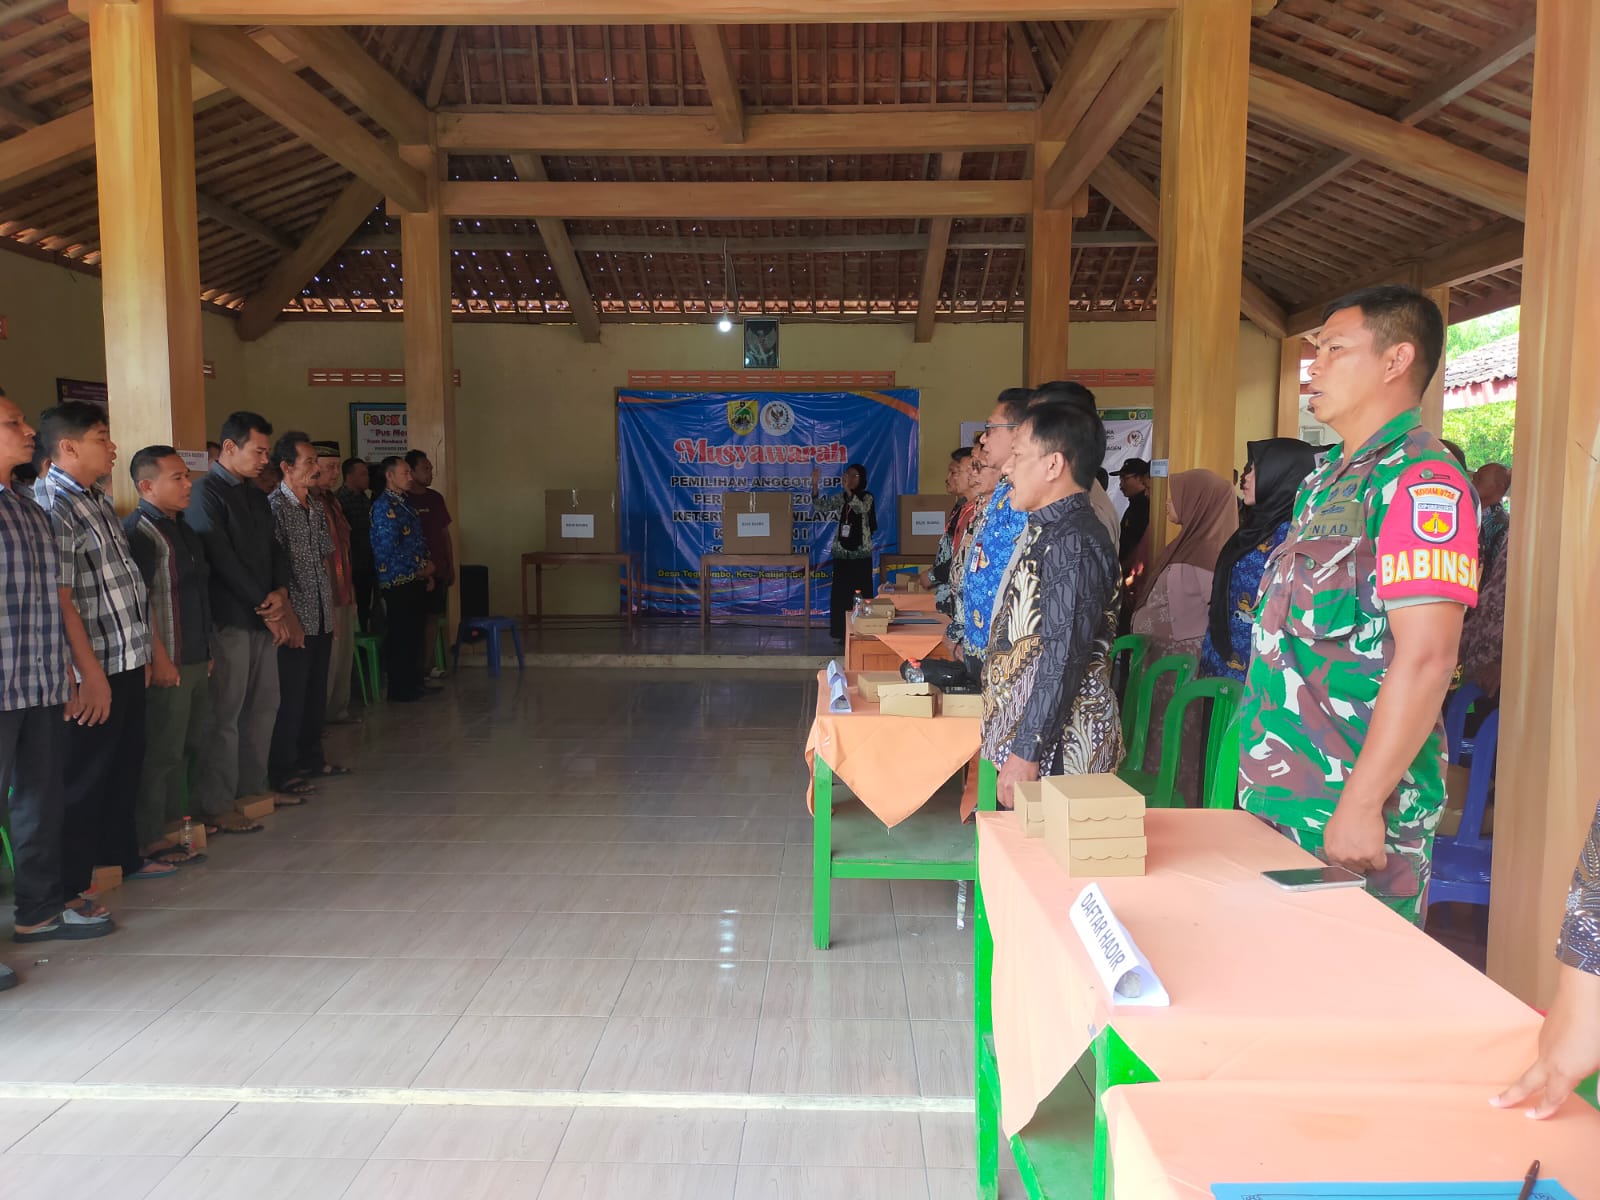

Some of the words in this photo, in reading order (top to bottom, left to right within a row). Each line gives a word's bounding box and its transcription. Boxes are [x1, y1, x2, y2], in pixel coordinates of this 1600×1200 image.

[674, 438, 848, 469] Musyawarah
[671, 476, 747, 487] PEMILIHAN
[751, 476, 813, 487] ANGGOT
[823, 477, 842, 487] BP
[673, 511, 723, 522] KETER
[792, 511, 840, 522] WILAYA
[1382, 548, 1478, 593] BABINSA
[1080, 892, 1108, 938] DAFTAR
[1097, 928, 1126, 973] HADIR
